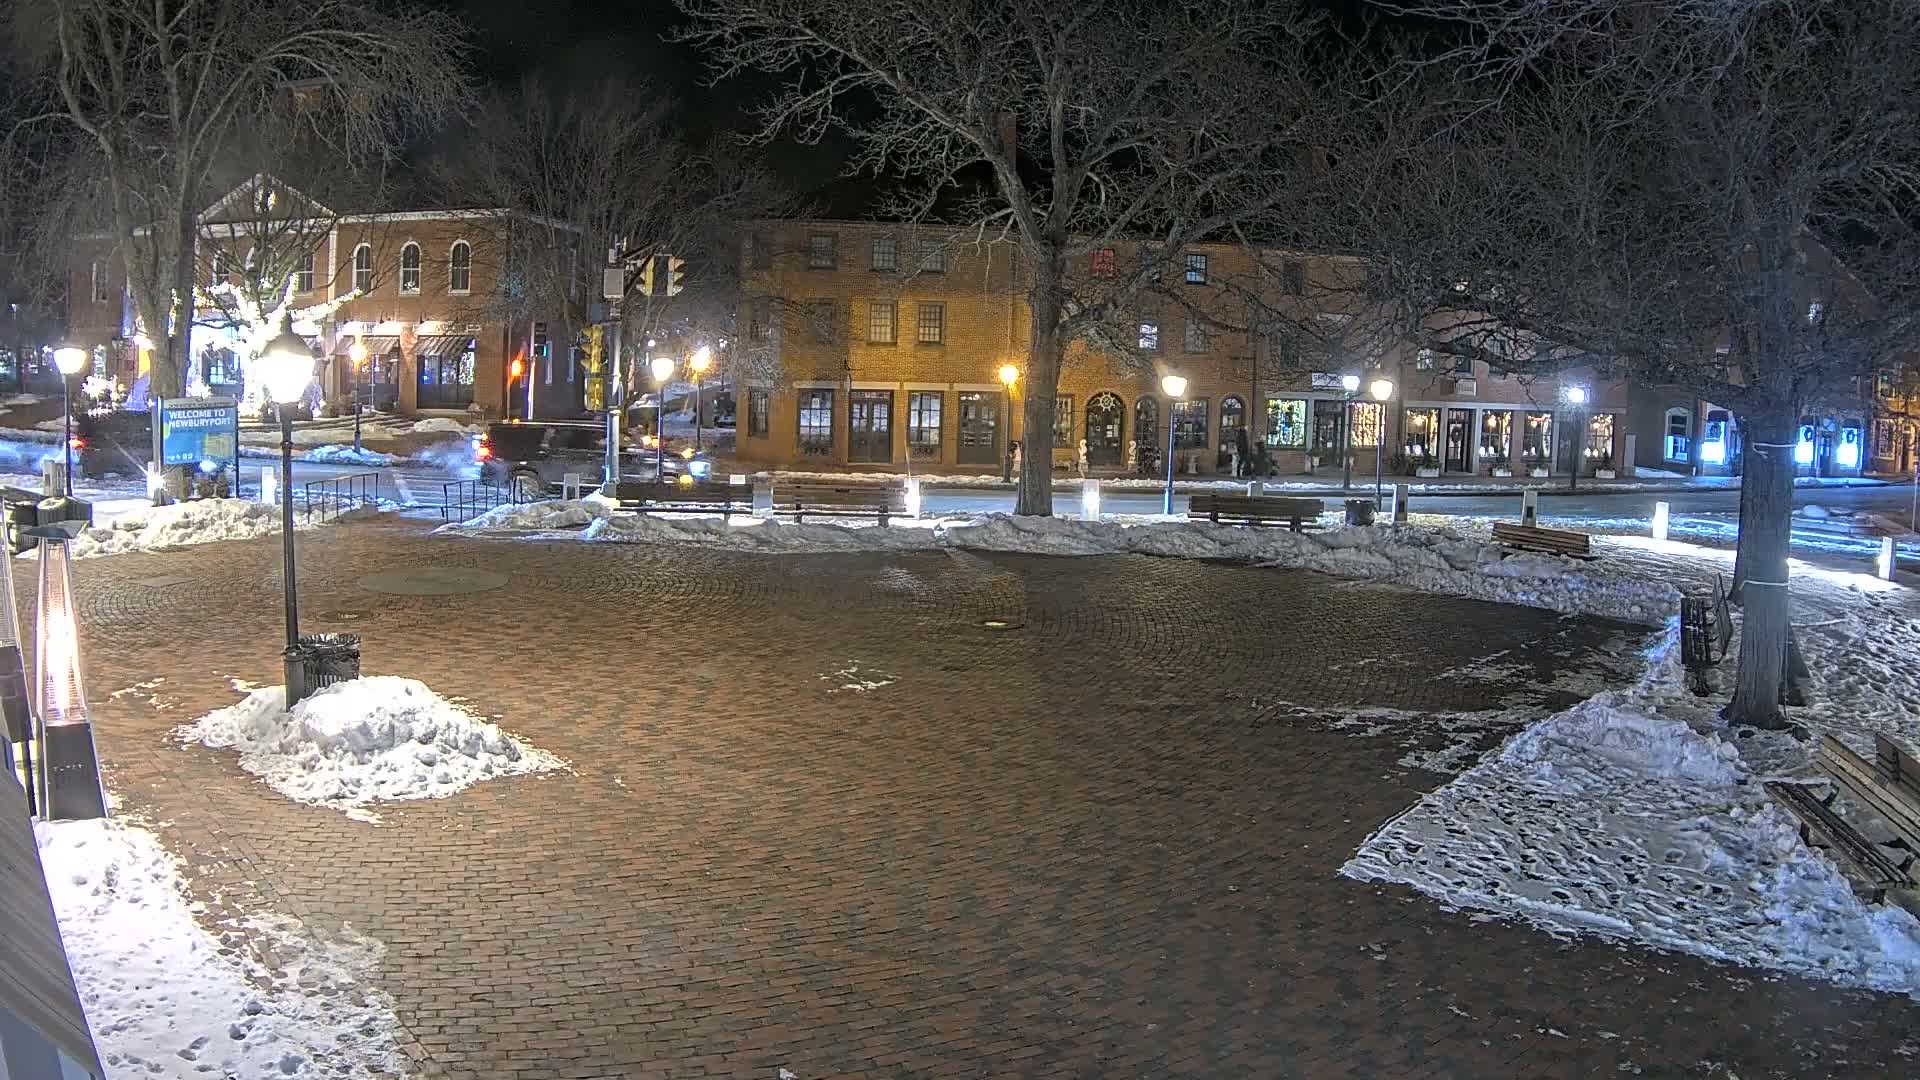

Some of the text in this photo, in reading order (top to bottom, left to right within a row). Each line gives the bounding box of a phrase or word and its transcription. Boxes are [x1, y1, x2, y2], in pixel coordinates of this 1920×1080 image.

[169, 409, 226, 419] WELCOME TO
[169, 417, 231, 428] NEWBURYPORT
